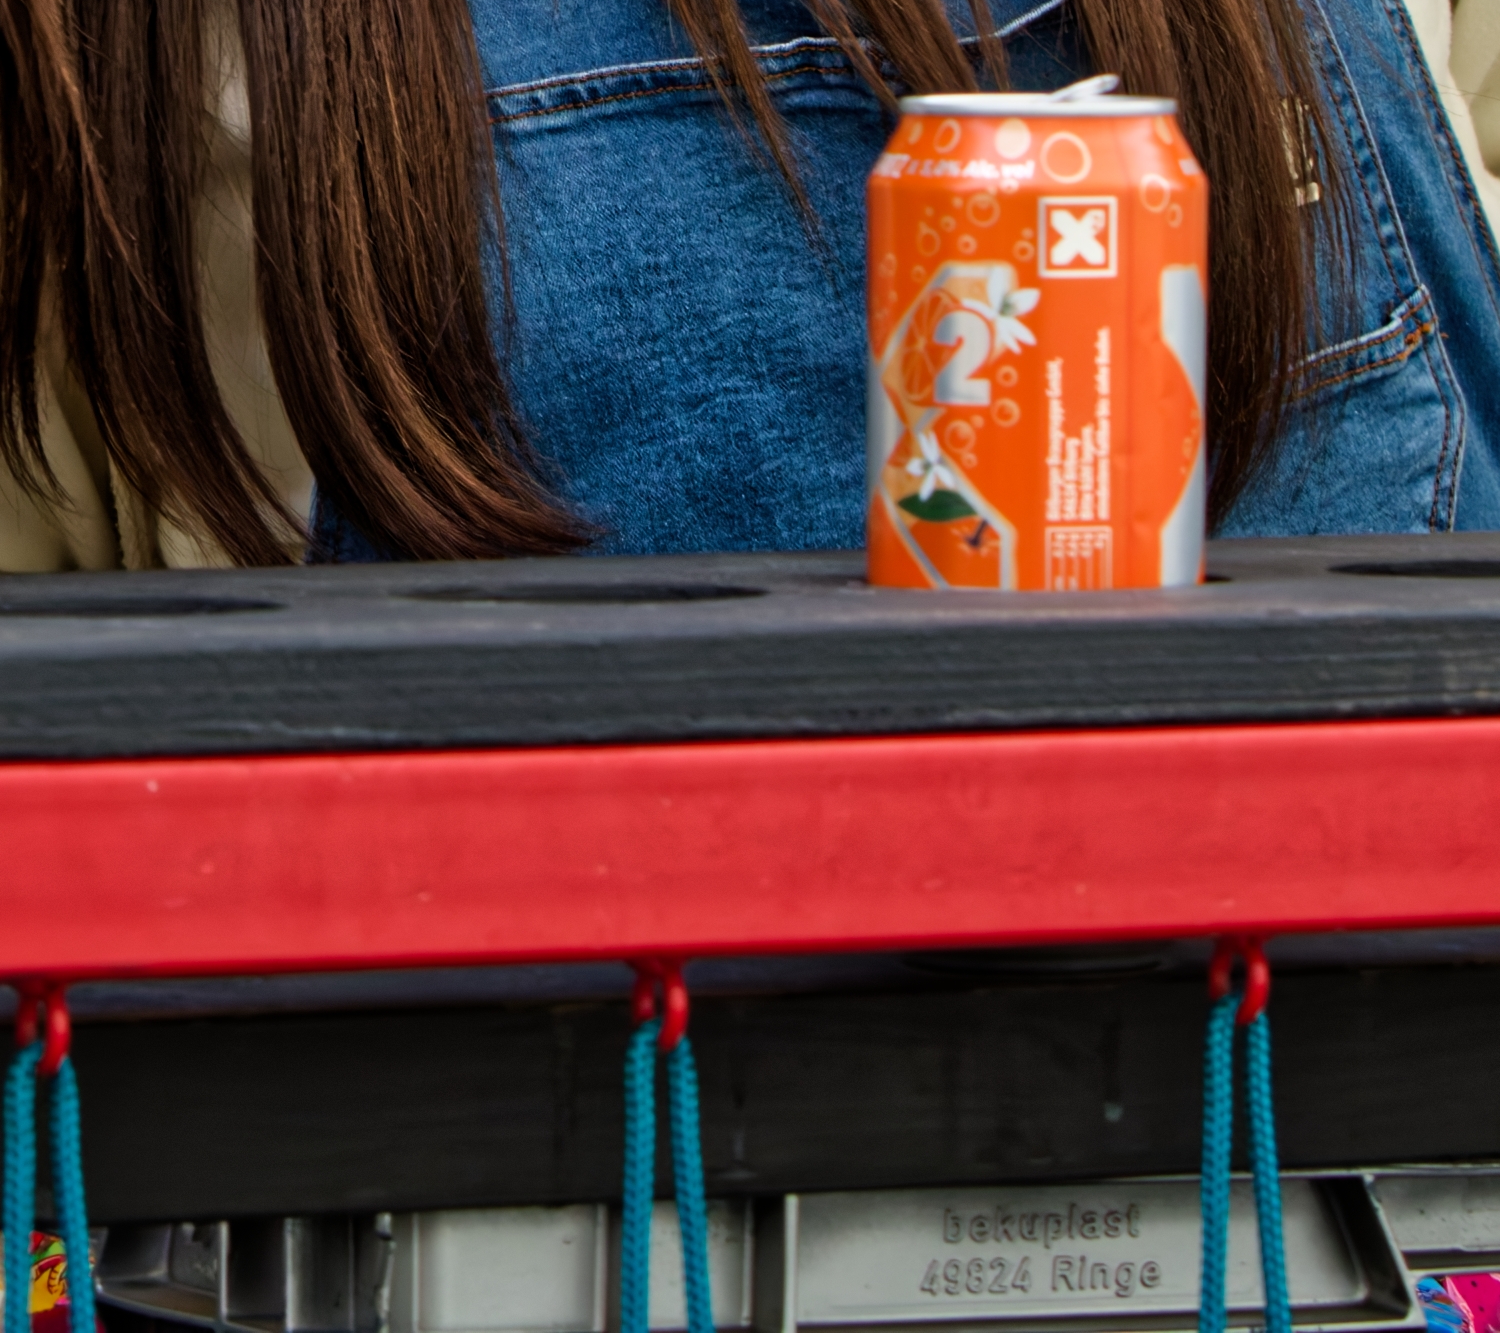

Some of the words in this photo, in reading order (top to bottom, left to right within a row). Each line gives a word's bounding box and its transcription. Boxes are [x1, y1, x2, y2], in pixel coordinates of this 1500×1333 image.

[943, 1203, 1140, 1249] bekuplast
[920, 1255, 1032, 1296] 49824
[1051, 1254, 1162, 1299] Ringe
